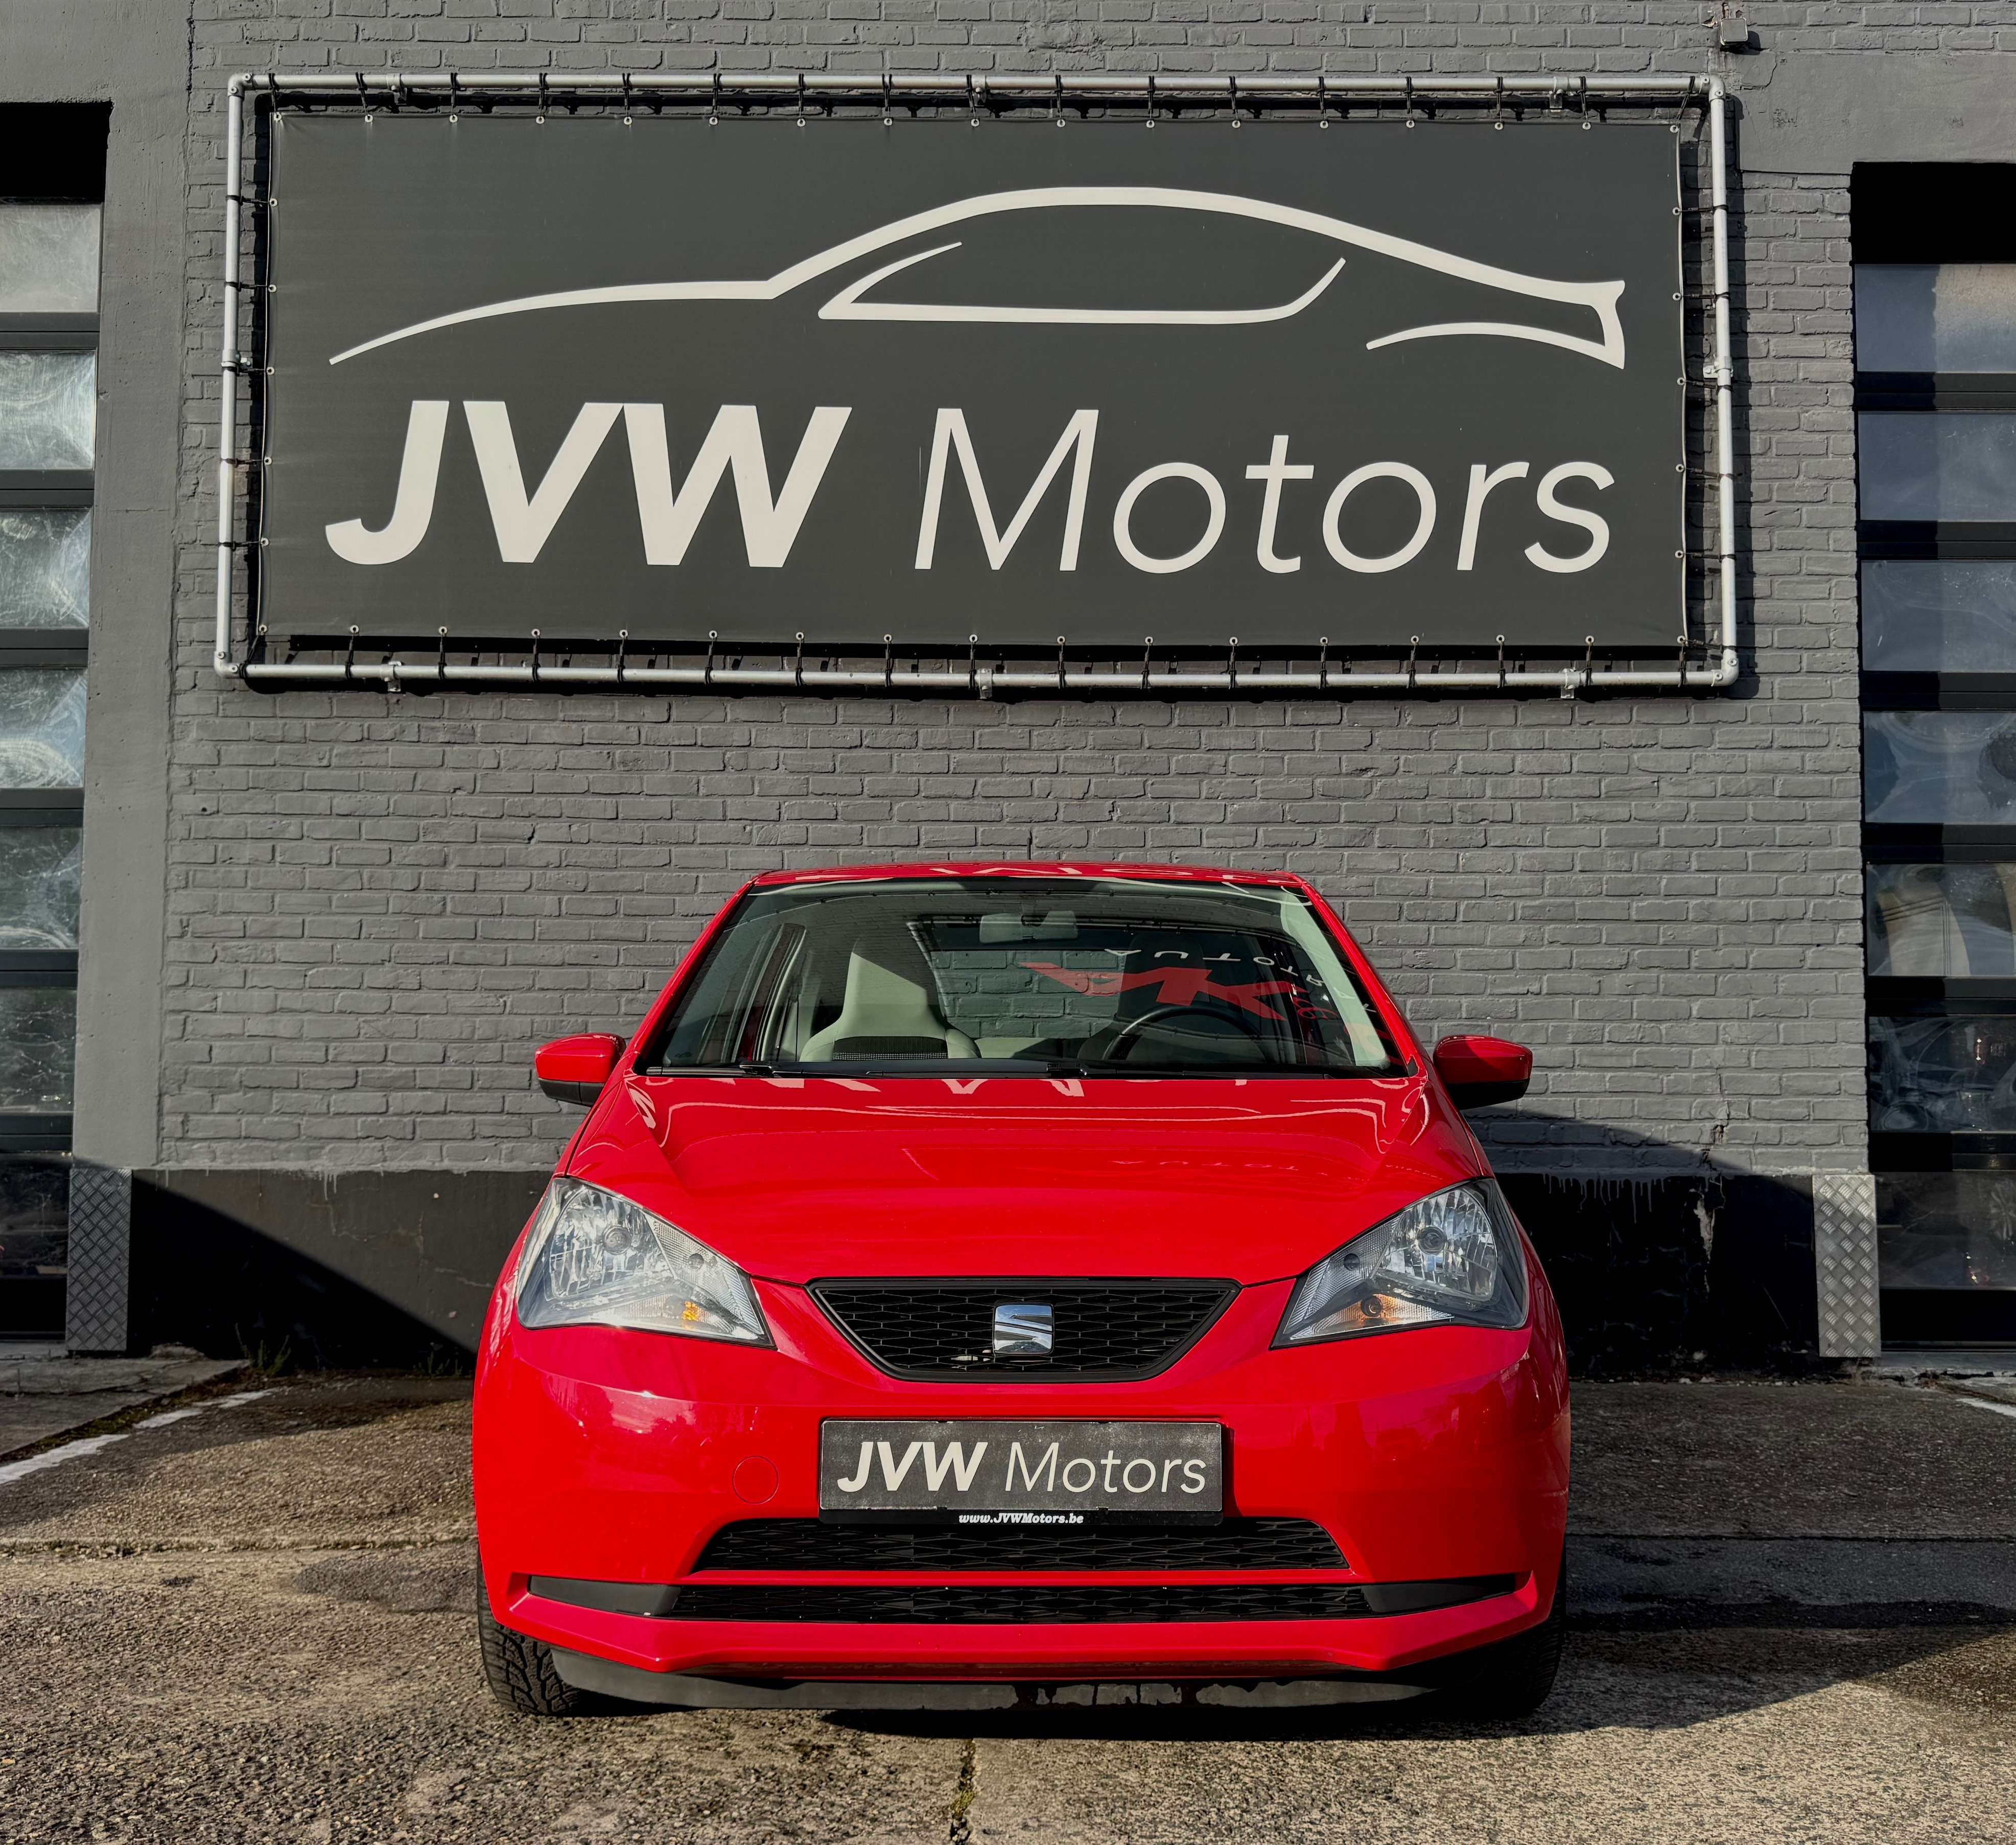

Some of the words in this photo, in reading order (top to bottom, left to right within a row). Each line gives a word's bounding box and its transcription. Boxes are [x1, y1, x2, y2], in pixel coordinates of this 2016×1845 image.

[325, 400, 852, 568] JVW
[915, 408, 1615, 574] Motors
[837, 1441, 989, 1493] JVW
[1005, 1442, 1206, 1494] Motors
[958, 1512, 1084, 1524] www.JVWMotors.be
